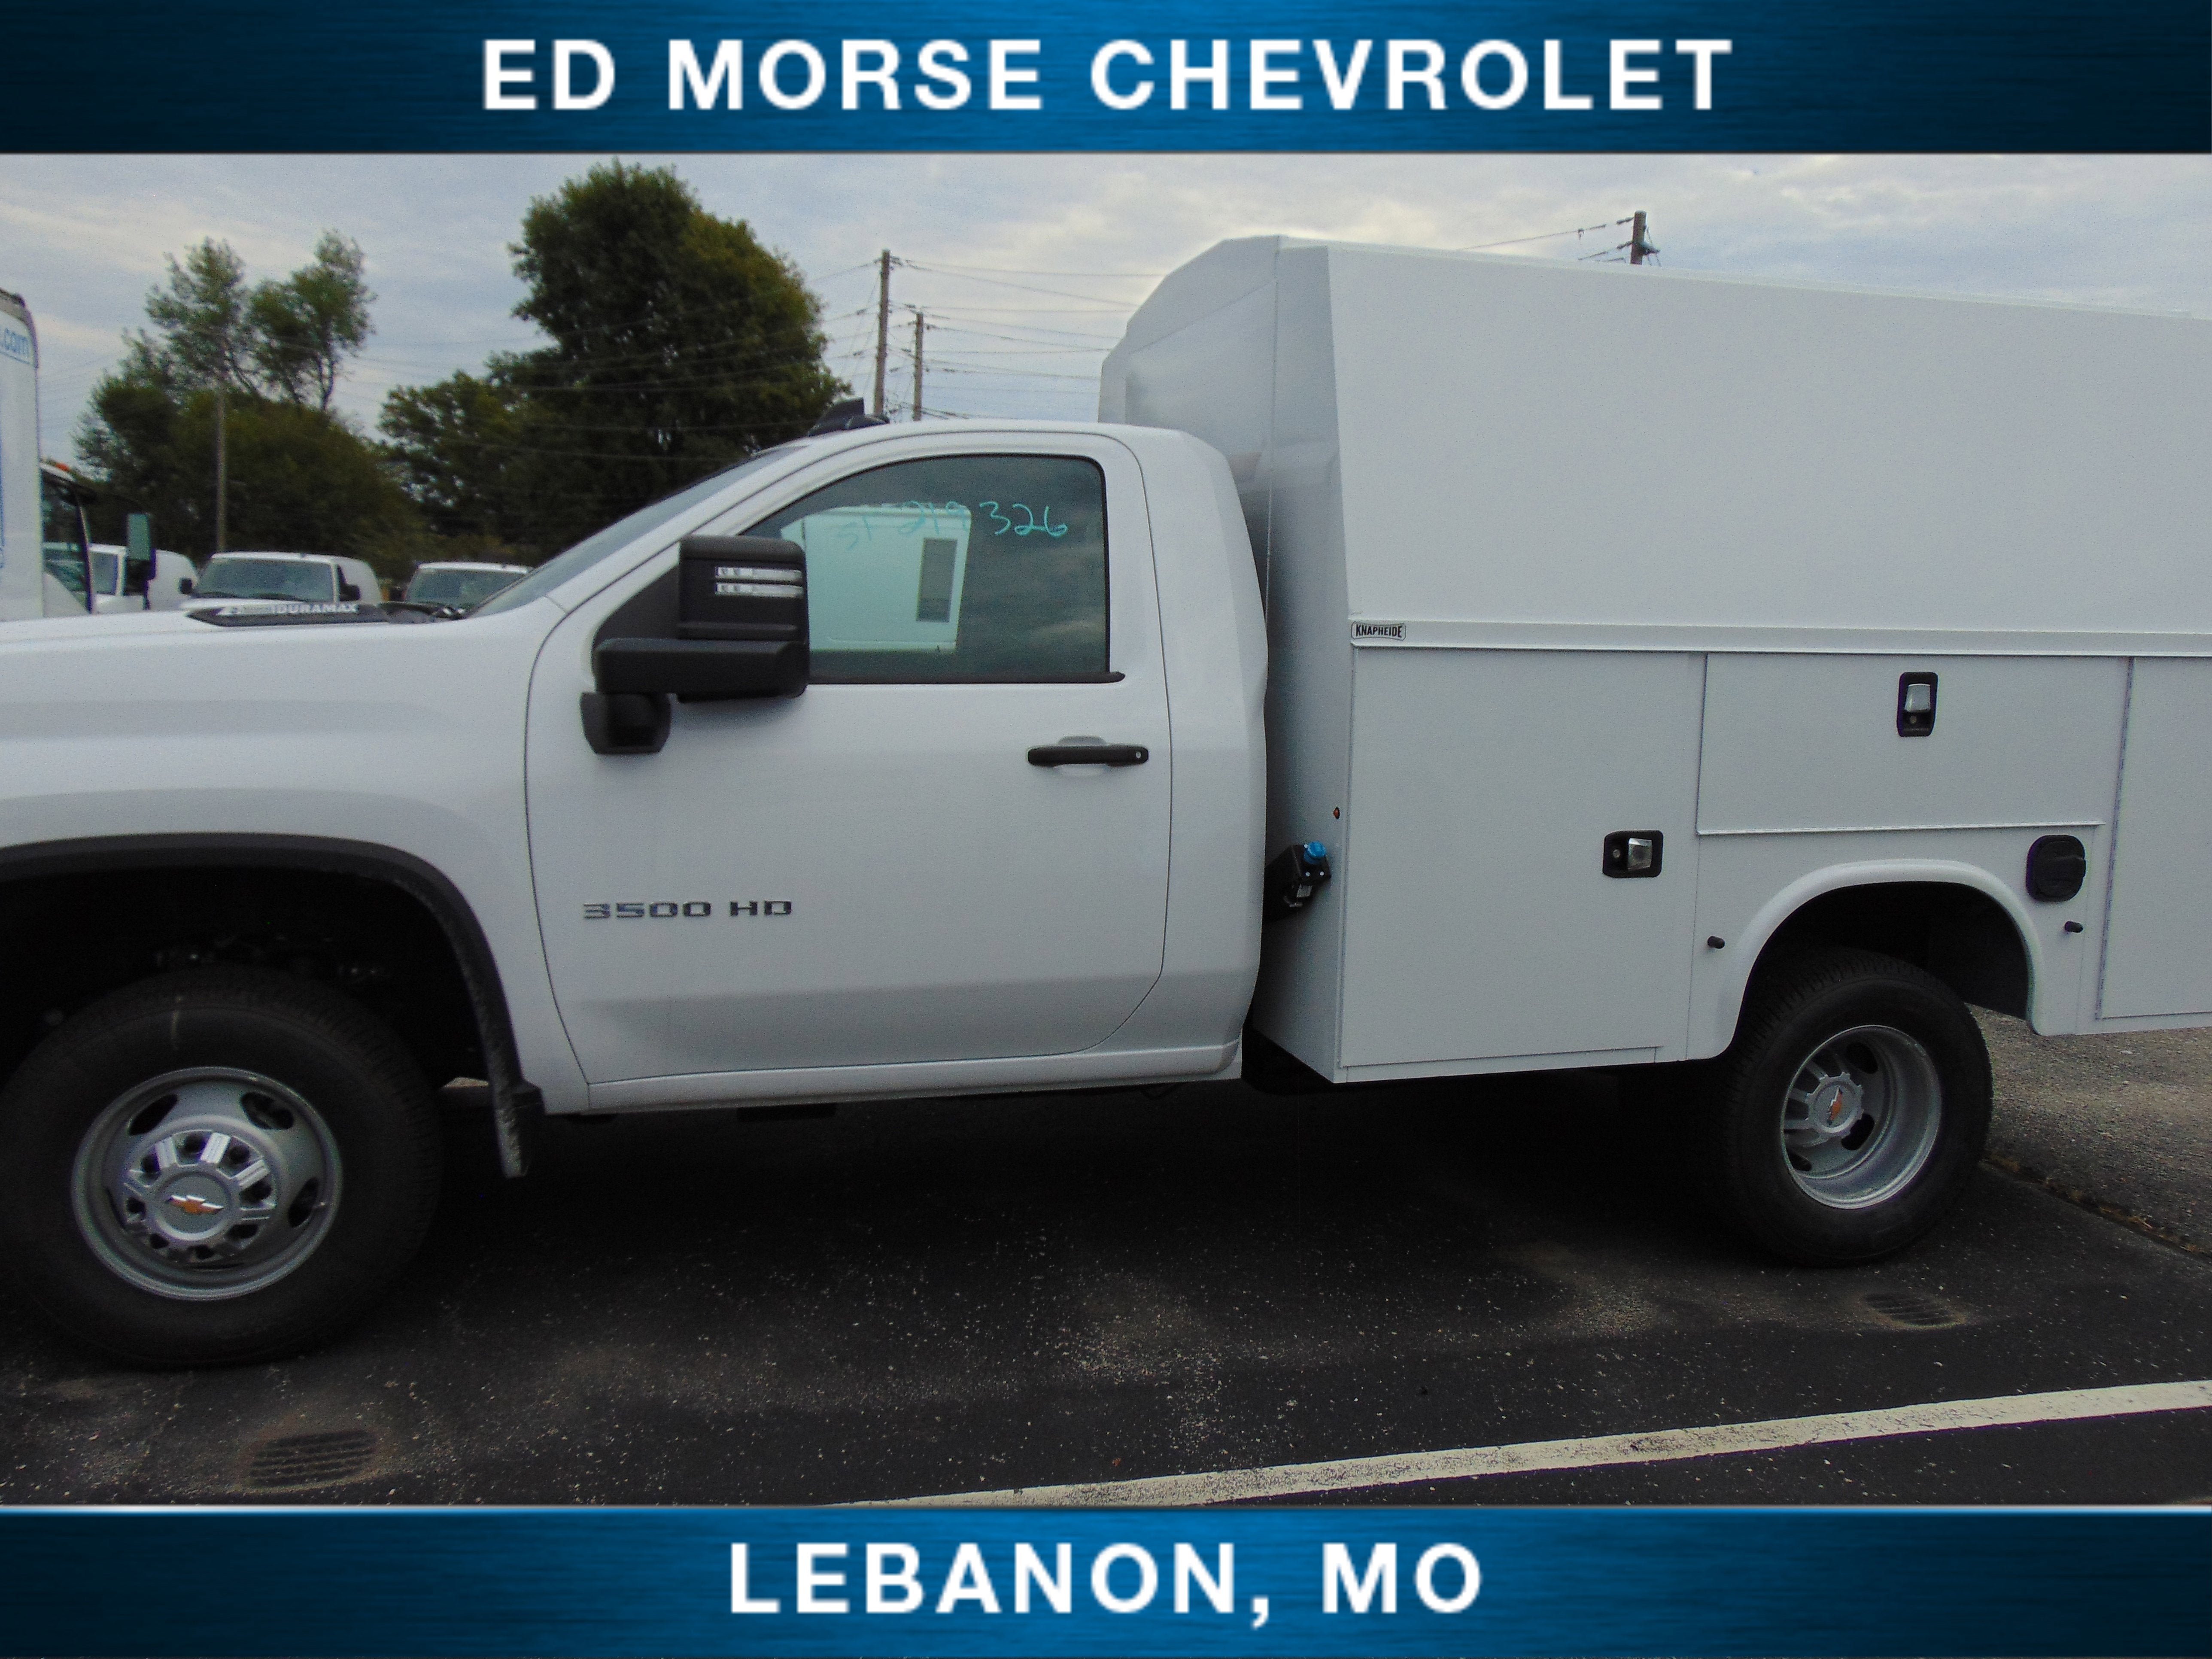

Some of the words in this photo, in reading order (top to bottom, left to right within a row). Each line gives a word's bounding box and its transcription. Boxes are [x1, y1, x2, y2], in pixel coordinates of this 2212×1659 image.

[978, 501, 1068, 538] 326
[1355, 623, 1403, 638] KNAPHEIDE
[583, 902, 711, 919] 3500
[730, 901, 792, 916] HD
